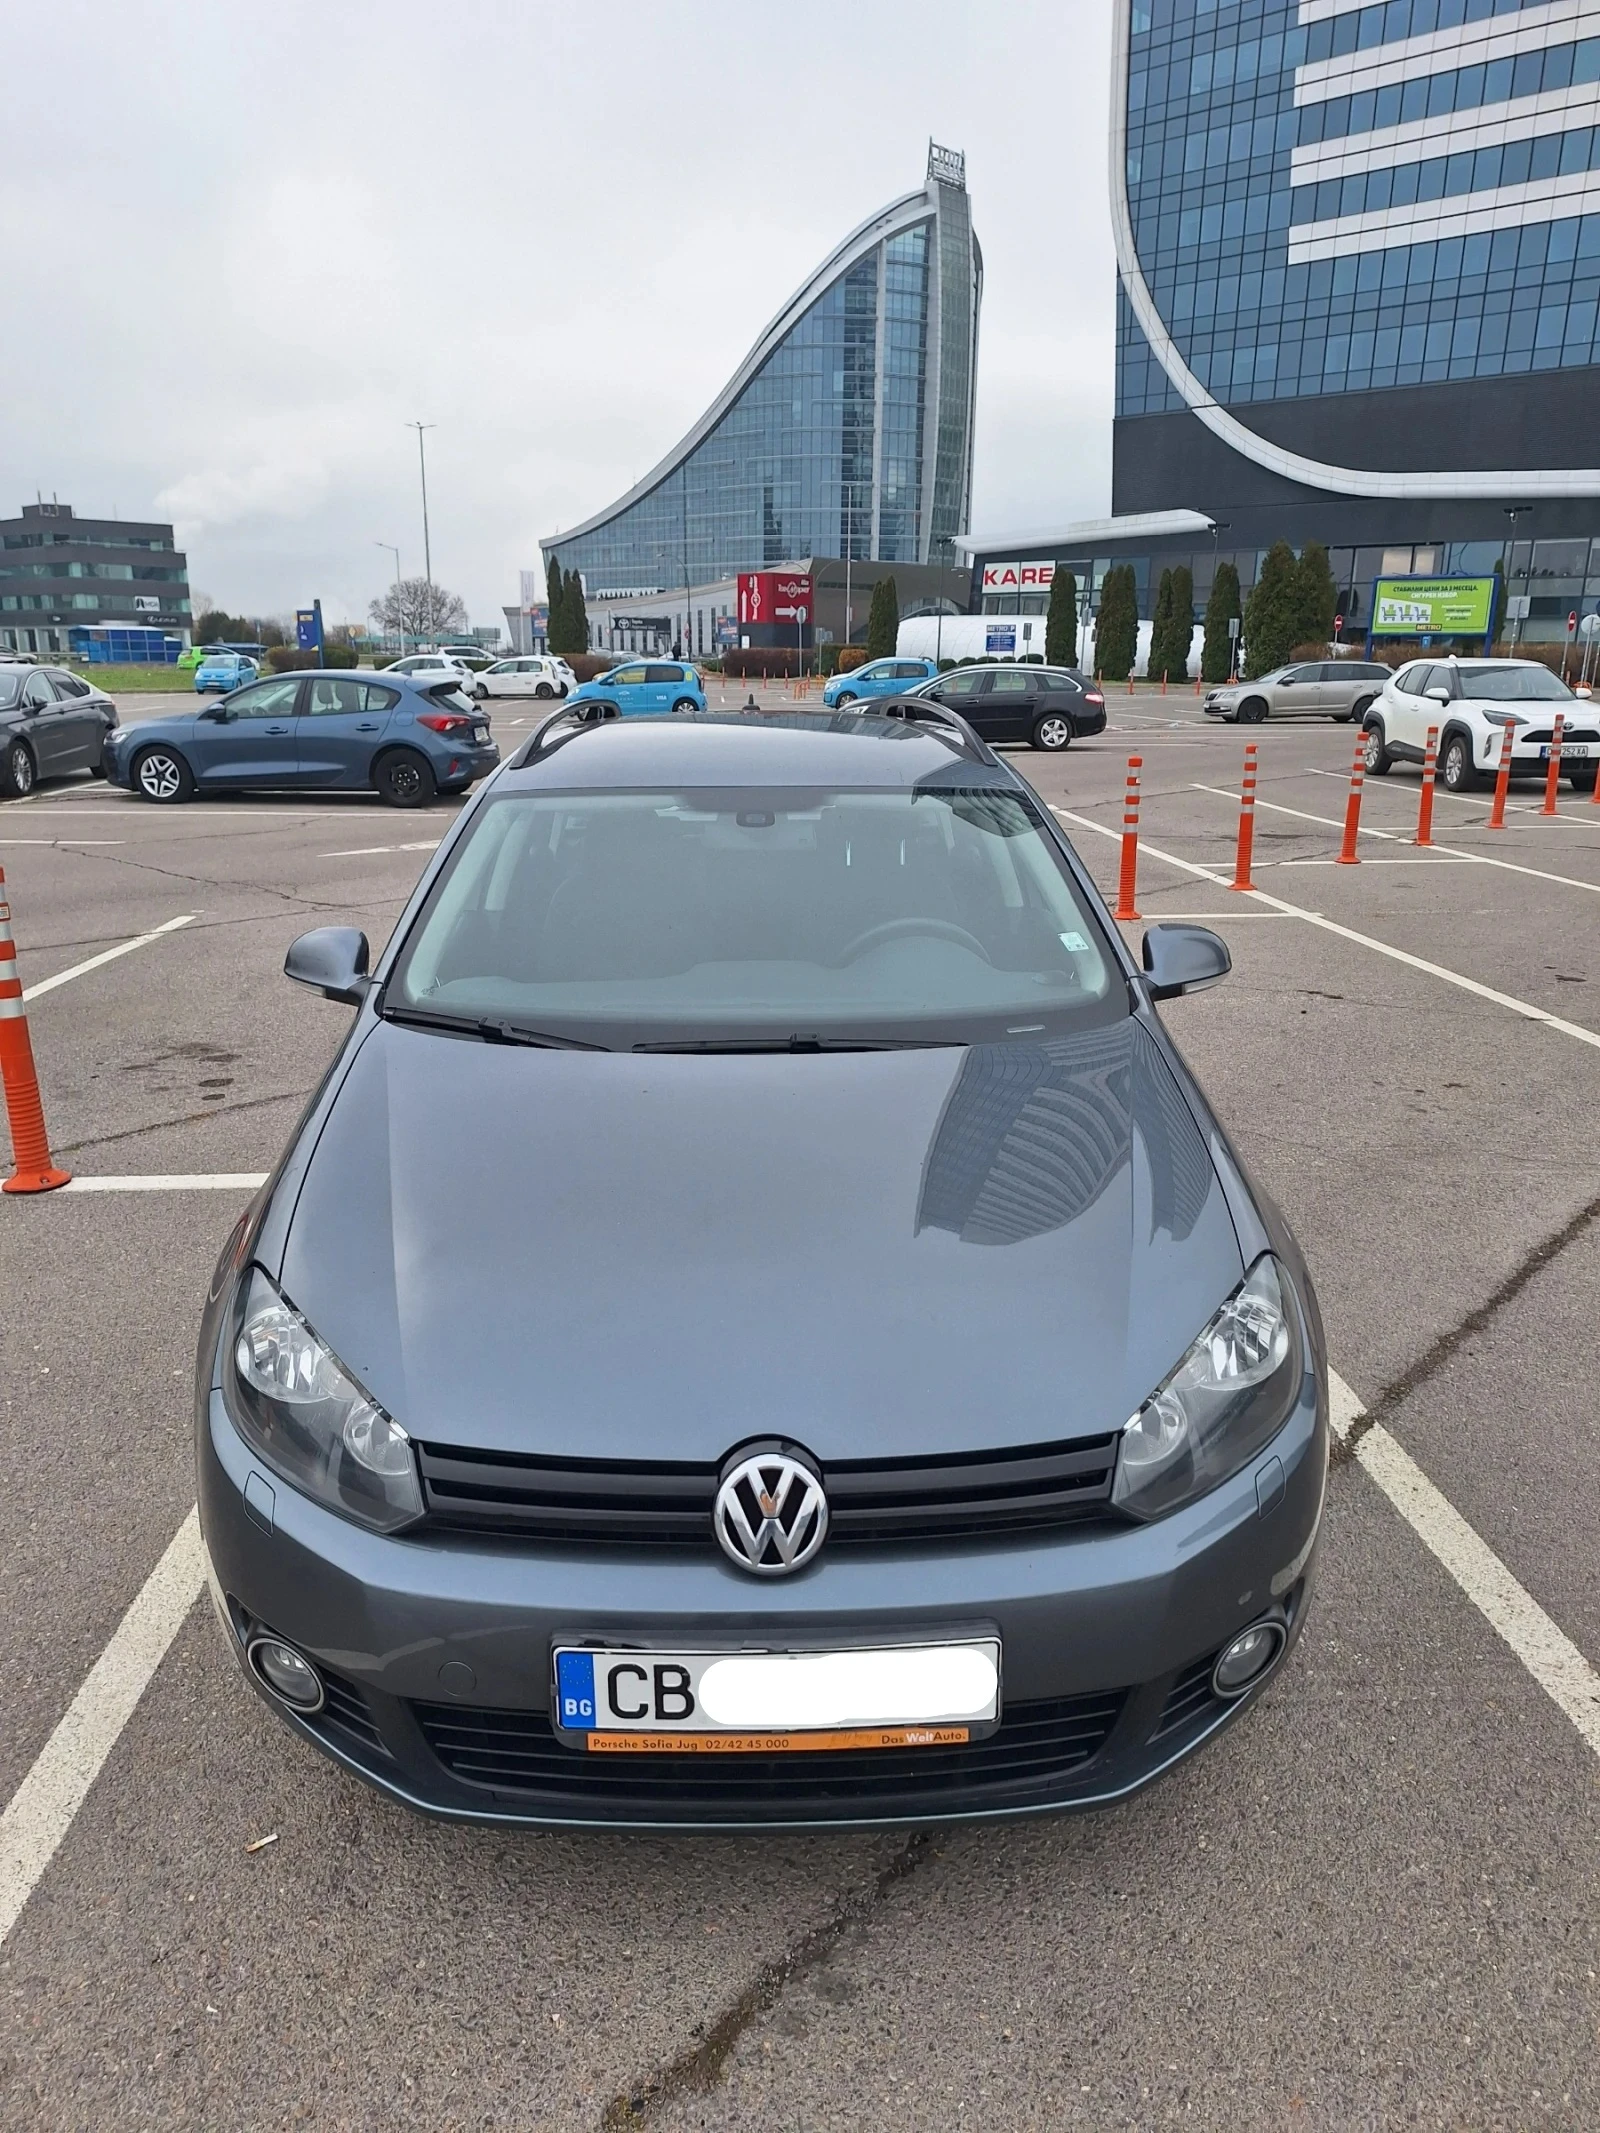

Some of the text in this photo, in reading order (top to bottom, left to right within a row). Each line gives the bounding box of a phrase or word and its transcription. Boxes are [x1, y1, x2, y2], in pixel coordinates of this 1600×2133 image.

[984, 568, 1053, 585] KARE
[607, 1664, 695, 1720] CB
[564, 1698, 592, 1716] BG
[593, 1738, 789, 1751] Porsche Sofia Jug 02/42 45 000
[881, 1735, 904, 1744] Das
